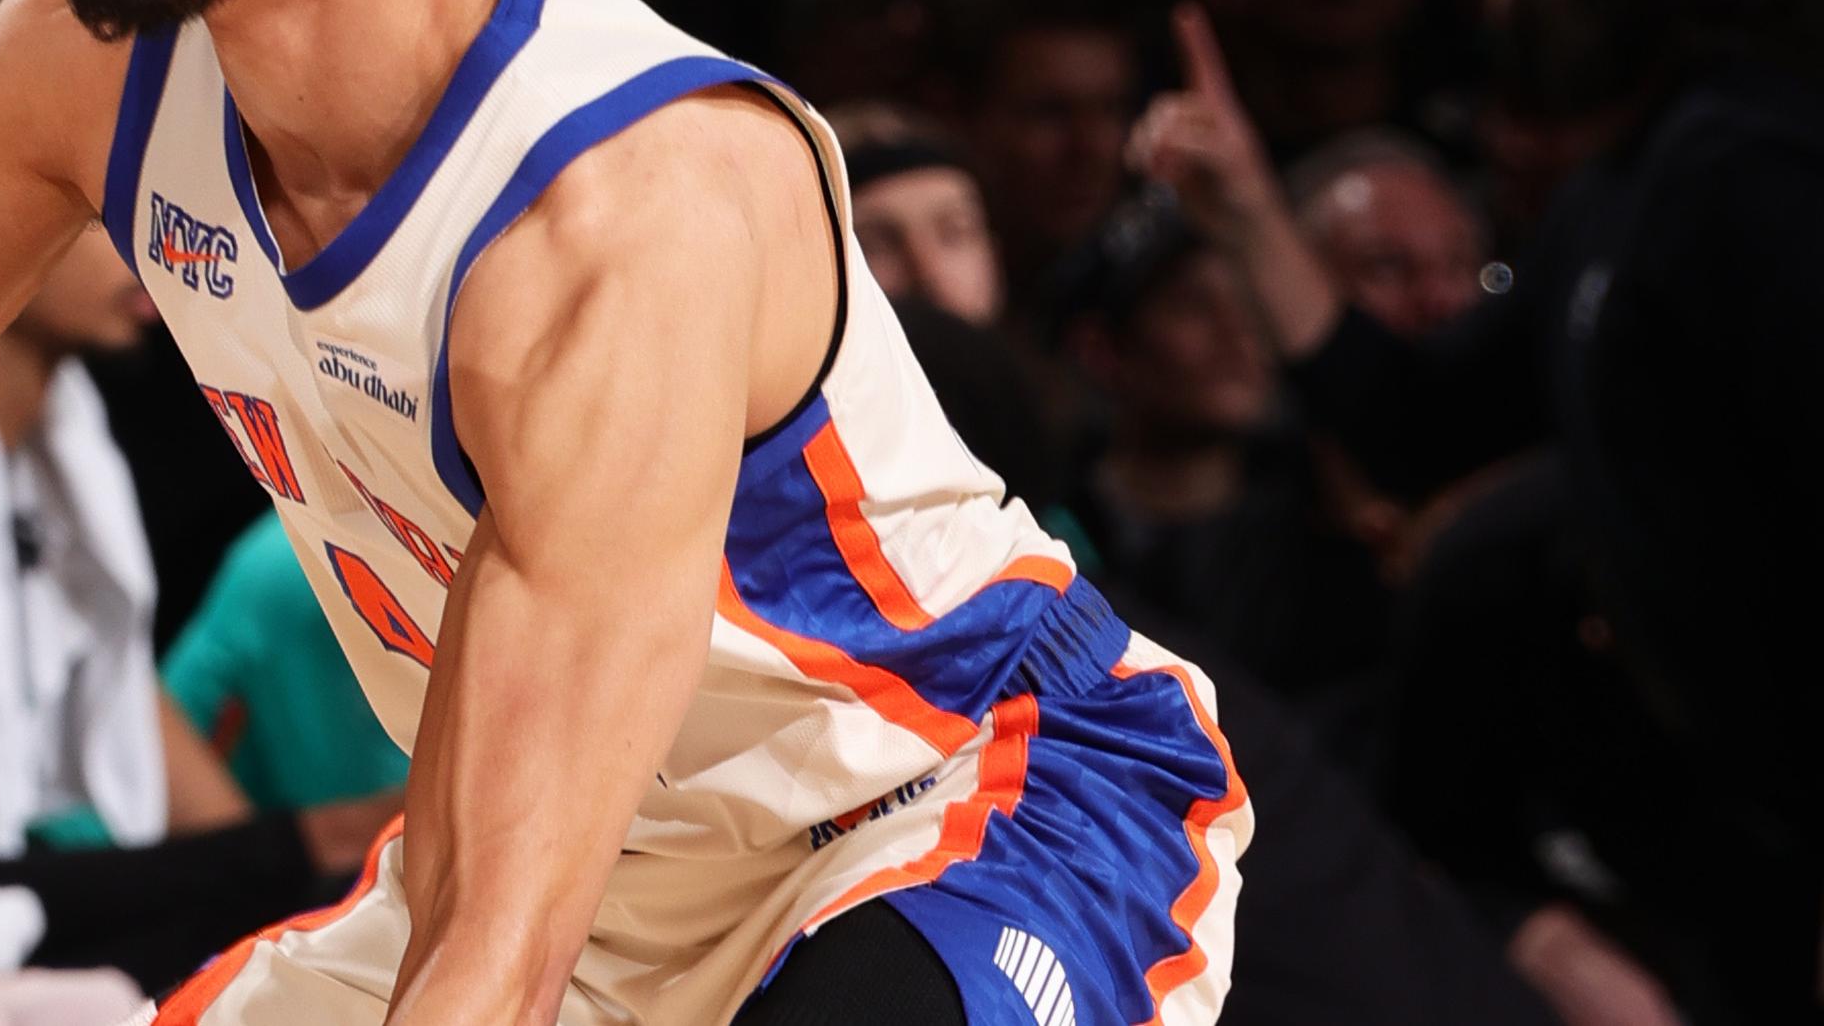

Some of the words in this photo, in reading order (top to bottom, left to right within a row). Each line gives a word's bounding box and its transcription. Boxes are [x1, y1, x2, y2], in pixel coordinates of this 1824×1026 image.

[148, 190, 238, 300] NYC
[316, 340, 377, 372] experience
[318, 356, 360, 391] abu
[363, 374, 419, 423] dhabi
